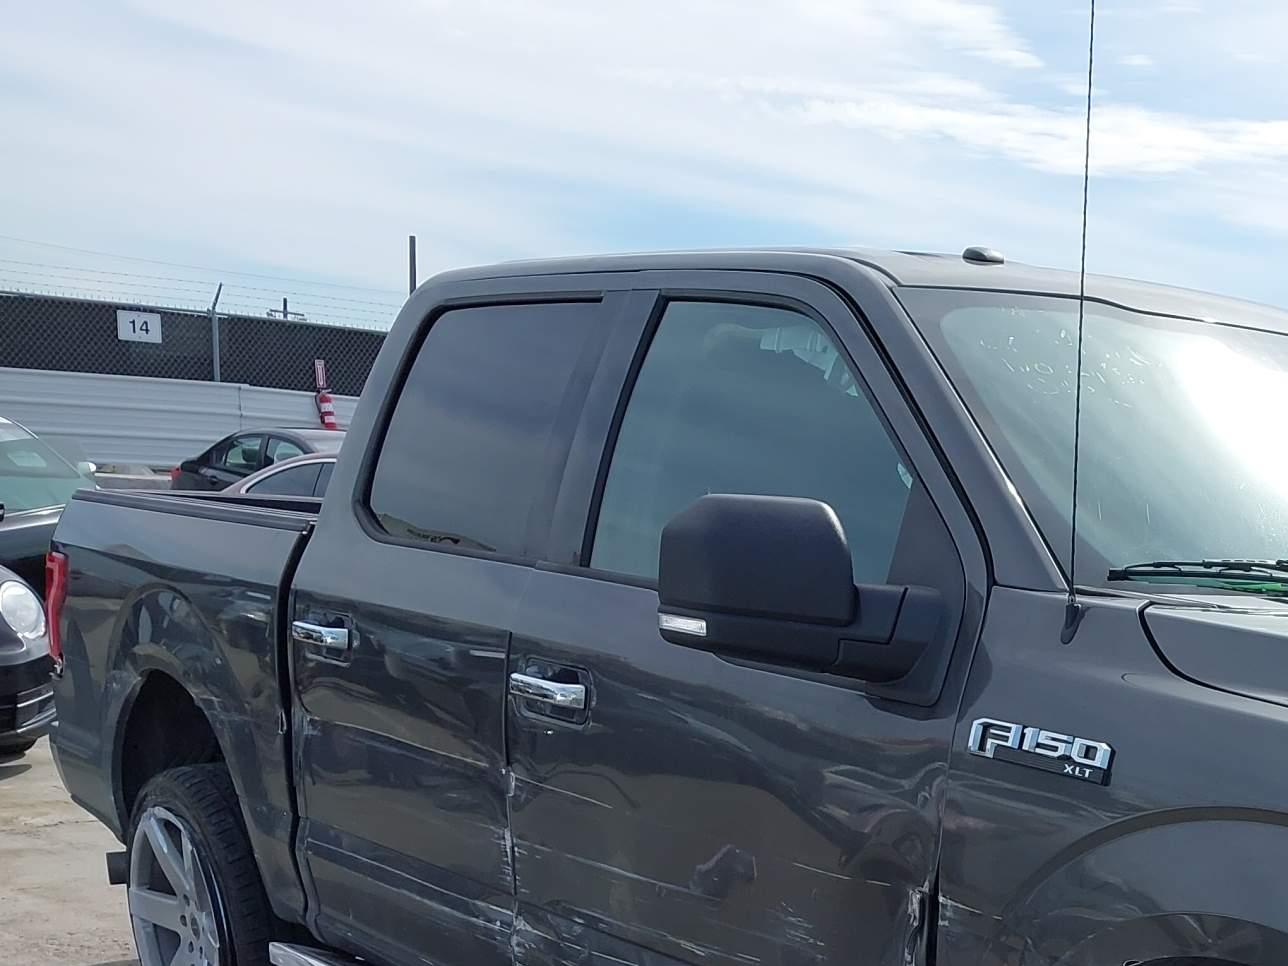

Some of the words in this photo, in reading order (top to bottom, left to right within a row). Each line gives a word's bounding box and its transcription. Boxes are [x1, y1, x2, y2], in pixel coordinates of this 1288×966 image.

[129, 319, 150, 335] 14
[968, 717, 1112, 769] F150
[1063, 763, 1093, 778] XLT
